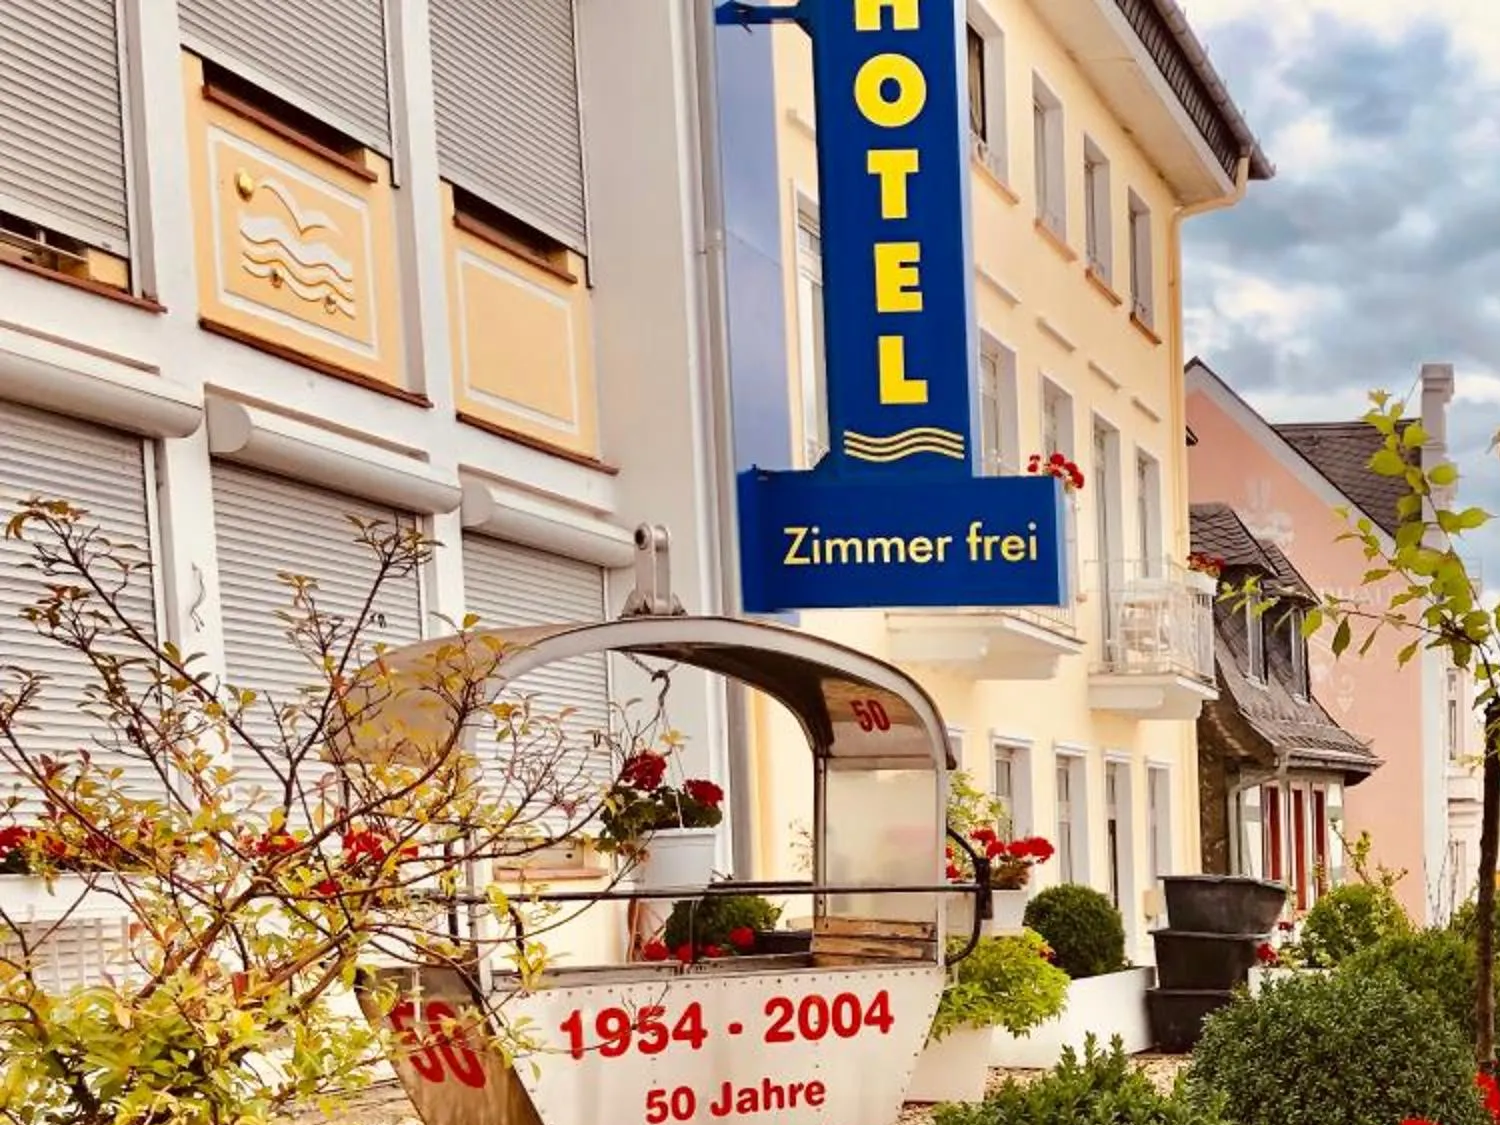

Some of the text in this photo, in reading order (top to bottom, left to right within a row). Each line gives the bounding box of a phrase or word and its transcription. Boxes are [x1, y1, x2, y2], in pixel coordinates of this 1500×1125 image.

[784, 522, 1038, 565] Zimmer frei
[849, 699, 892, 733] 50
[390, 999, 487, 1090] 50
[559, 1001, 709, 1061] 1954
[763, 990, 895, 1044] 2004
[645, 1078, 827, 1125] 50 Jahre
